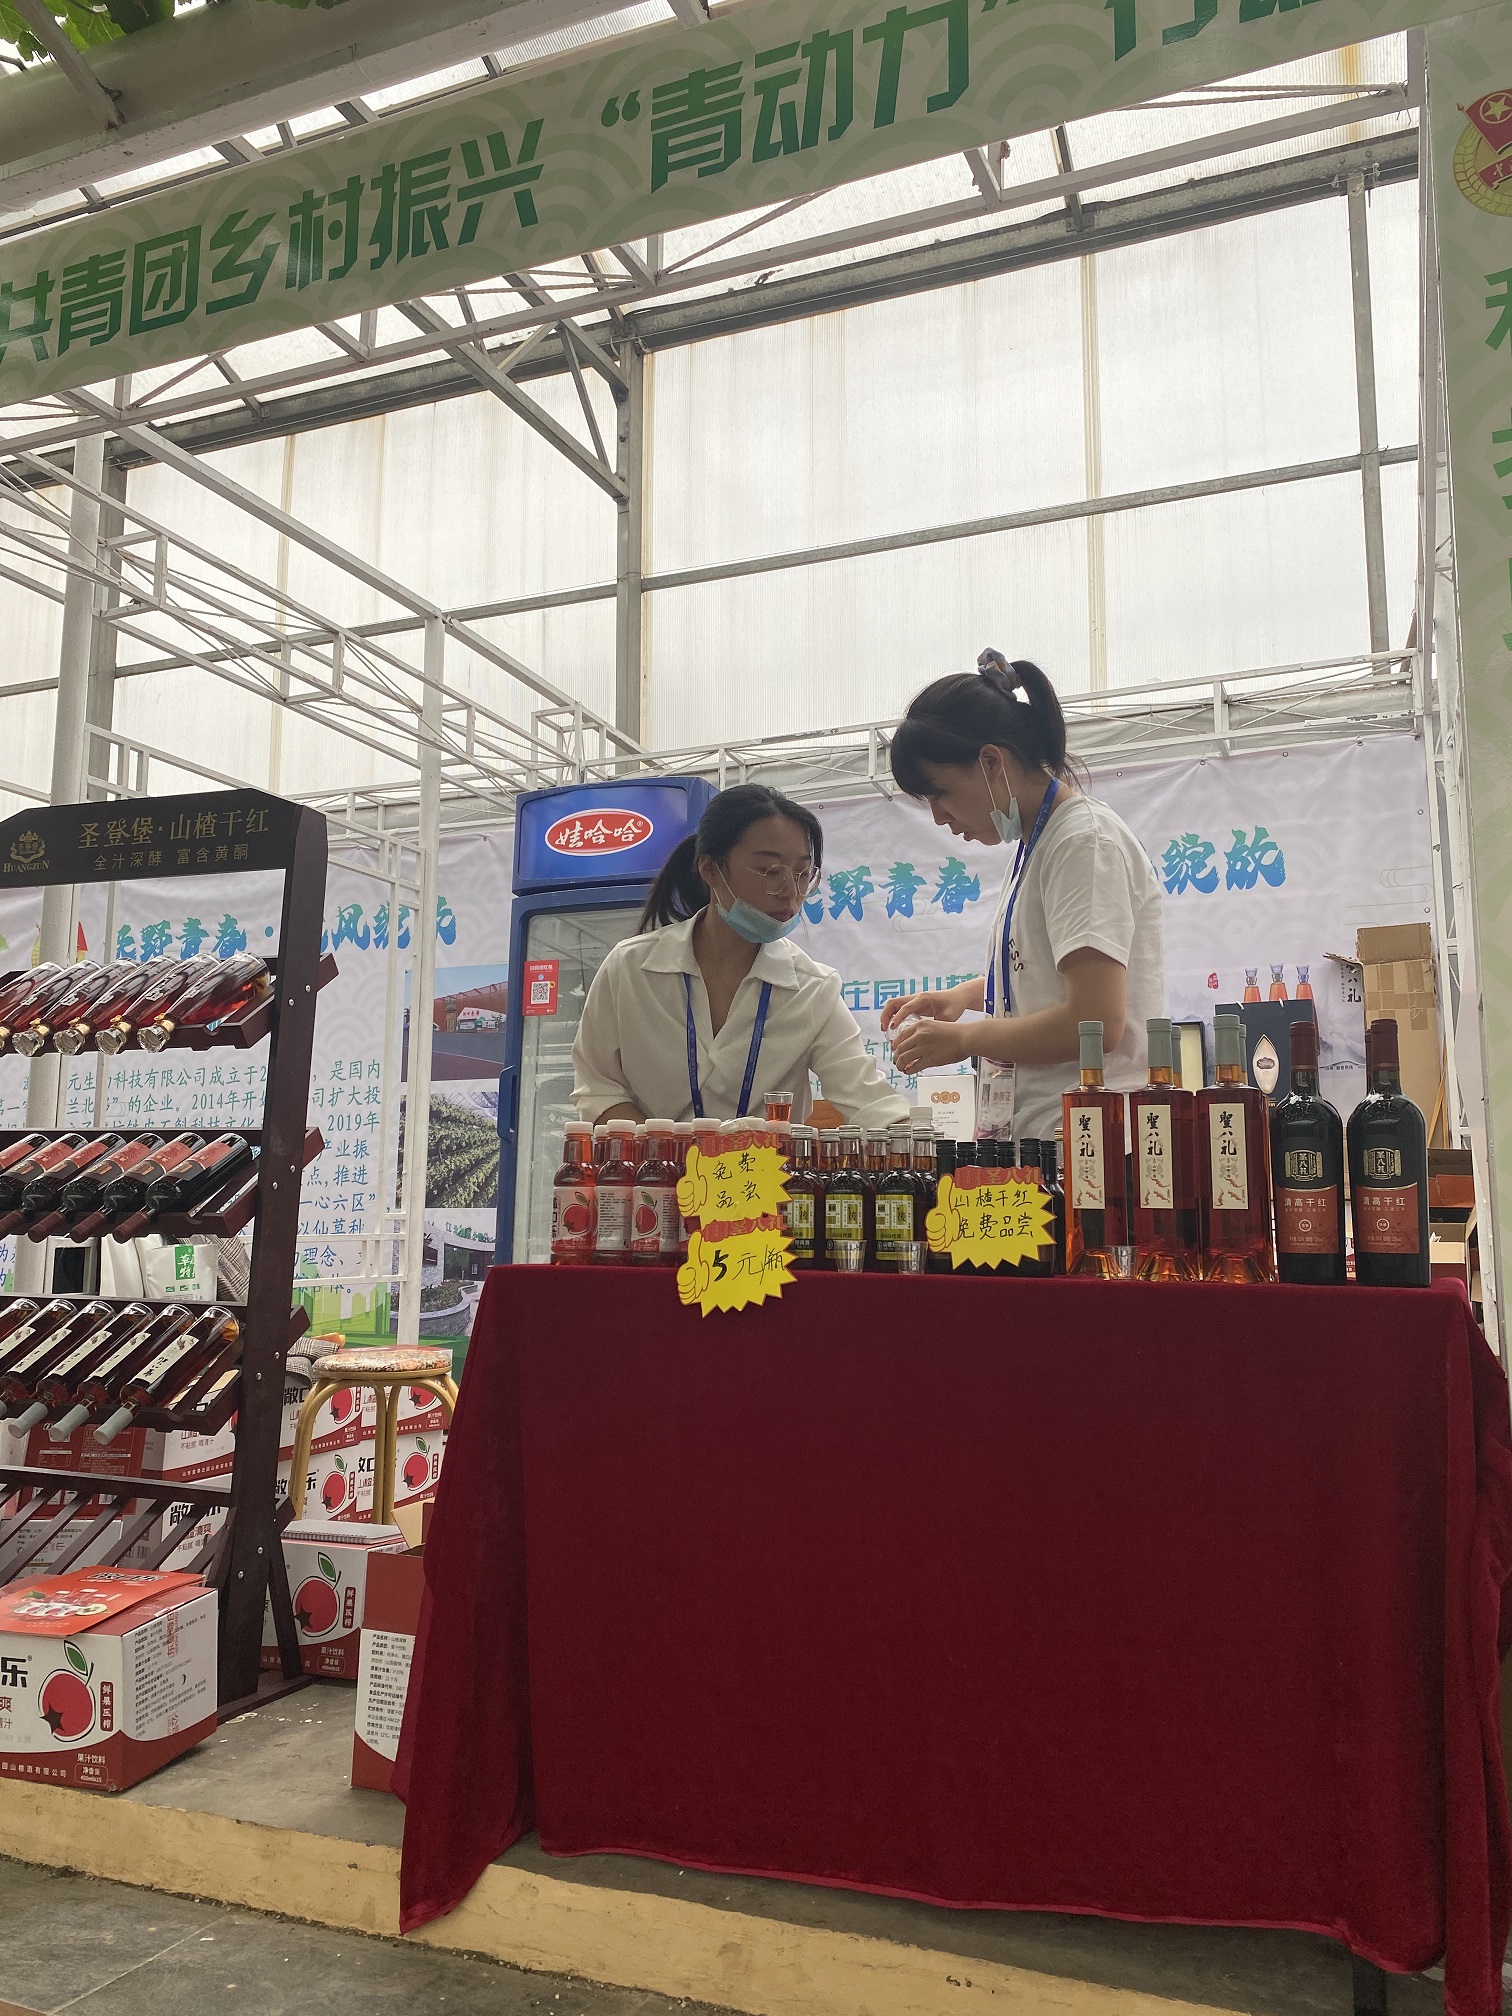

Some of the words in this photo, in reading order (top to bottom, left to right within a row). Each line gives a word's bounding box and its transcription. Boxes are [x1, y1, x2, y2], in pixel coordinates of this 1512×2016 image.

[78, 808, 269, 849] 圣登堡·山楂干红
[555, 819, 641, 848] 娃哈哈
[94, 851, 162, 871] 全汁深酵
[177, 843, 249, 865] 富含黄酮
[803, 857, 981, 924] 野青春
[312, 1086, 381, 1108] 司扩大投
[327, 1111, 380, 1133] 2019年
[985, 1168, 1043, 1184] 圣八礼
[954, 1188, 1033, 1209] 山楂干红
[959, 1212, 1034, 1240] 免费品尝
[102, 1684, 112, 1729] 鲜果压榨
[77, 1753, 105, 1764] 果汁饮料
